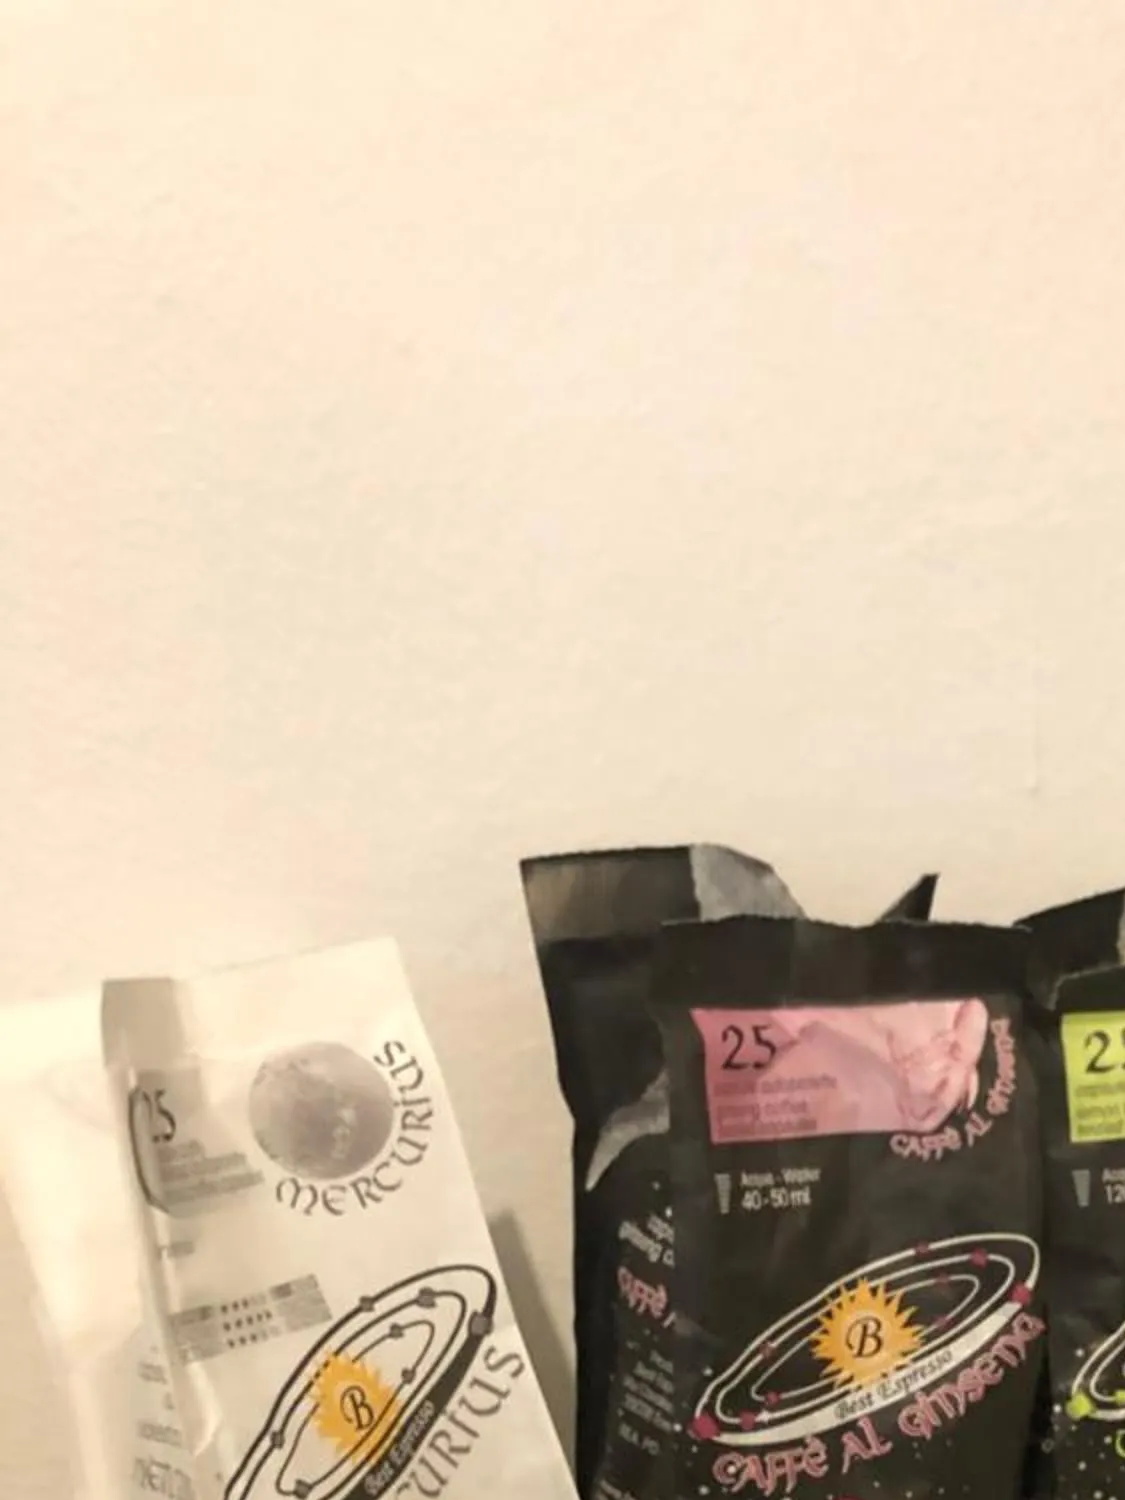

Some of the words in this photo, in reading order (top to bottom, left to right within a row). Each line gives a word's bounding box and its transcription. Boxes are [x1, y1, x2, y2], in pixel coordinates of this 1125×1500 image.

[721, 1025, 776, 1071] 25
[276, 1040, 434, 1216] MERCURIUS
[845, 1316, 884, 1359] B
[339, 1384, 375, 1432] B
[840, 1415, 893, 1475] AL
